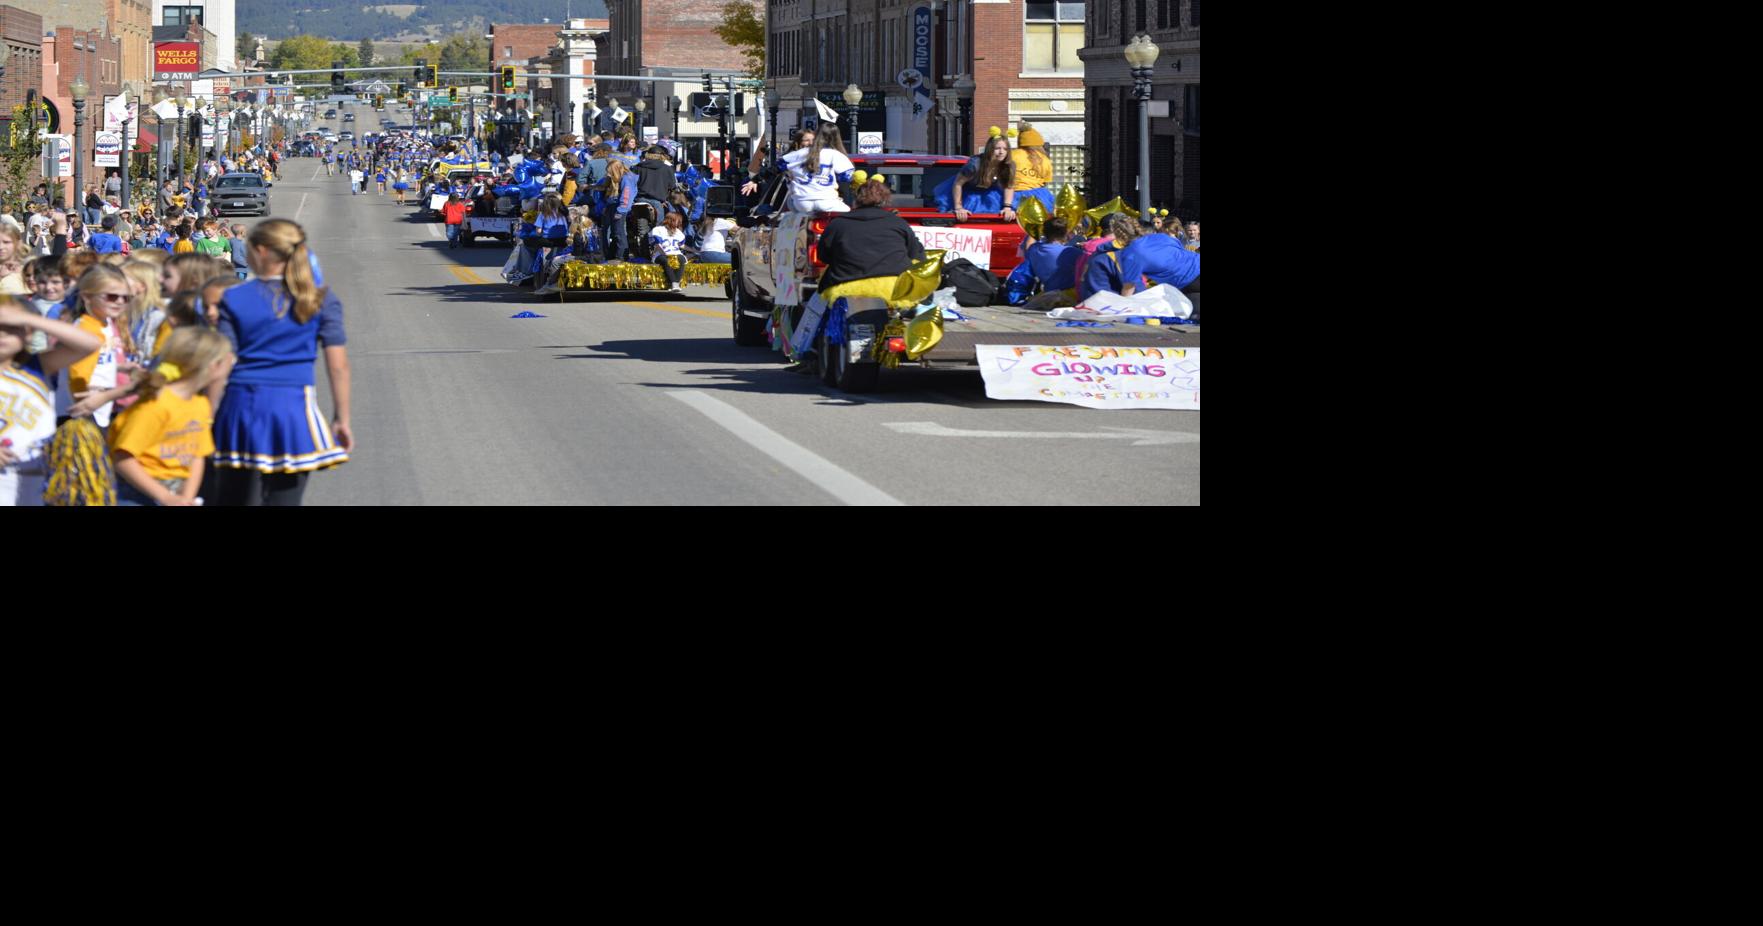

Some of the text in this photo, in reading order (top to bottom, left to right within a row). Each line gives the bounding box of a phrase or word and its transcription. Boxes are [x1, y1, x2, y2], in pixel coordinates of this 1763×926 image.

[915, 14, 929, 68] MOOSE
[1012, 346, 1187, 359] FRESHMAN
[1031, 361, 1167, 377] GLOWING
